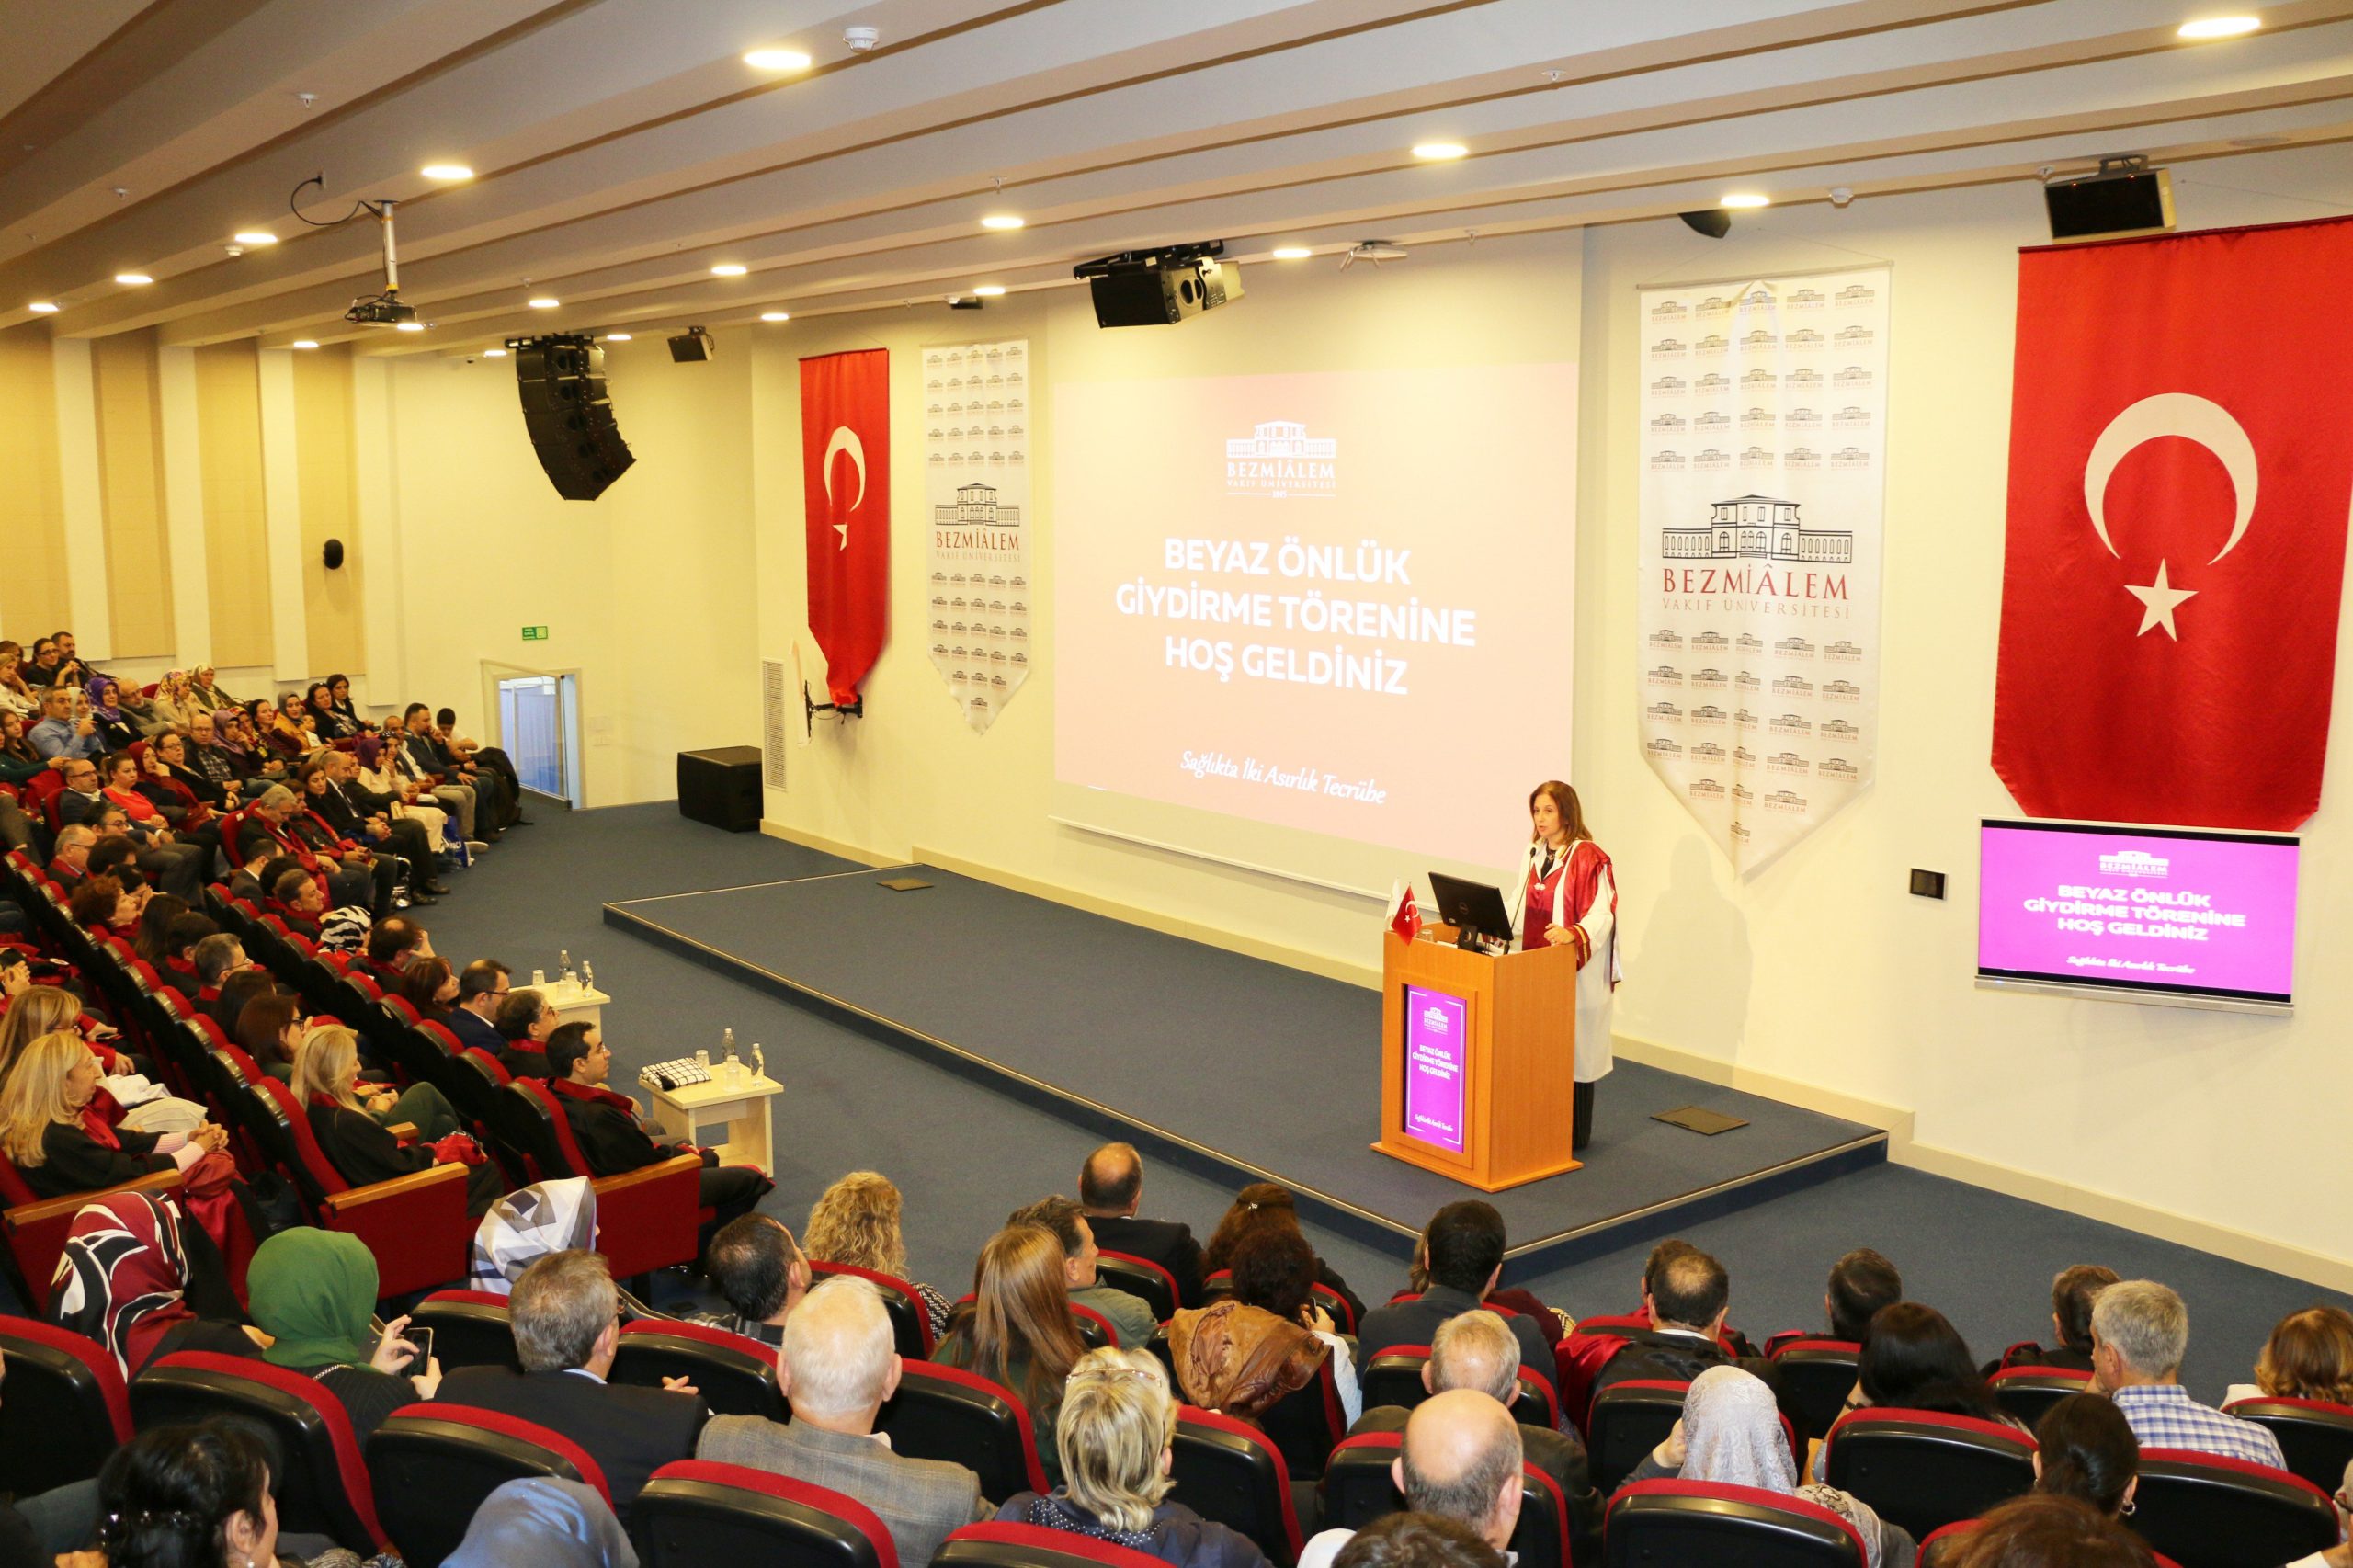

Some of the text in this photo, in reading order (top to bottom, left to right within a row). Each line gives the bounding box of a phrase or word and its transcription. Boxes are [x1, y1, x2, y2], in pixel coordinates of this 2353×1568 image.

[936, 528, 1019, 551] BEZMİÂLEM
[1165, 535, 1412, 585] BEYAZ ÖNLÜK
[1663, 563, 1849, 600] BEZMİÂLEM
[1116, 576, 1476, 647] GİYDİRME TÖRENİNE
[1662, 598, 1712, 611] VAKIF
[1165, 635, 1408, 695] HOŞ GELDİNİZ
[1180, 750, 1239, 778] Sağlıkta
[1264, 765, 1317, 792] Asırlık
[1322, 774, 1387, 804] Tecrübe
[2023, 897, 2246, 927] GİYDİRME TÖRENİNE
[2058, 884, 2211, 908] BEYAZ ÖNLÜK
[2057, 917, 2209, 941] HOŞ GELDİNİZ
